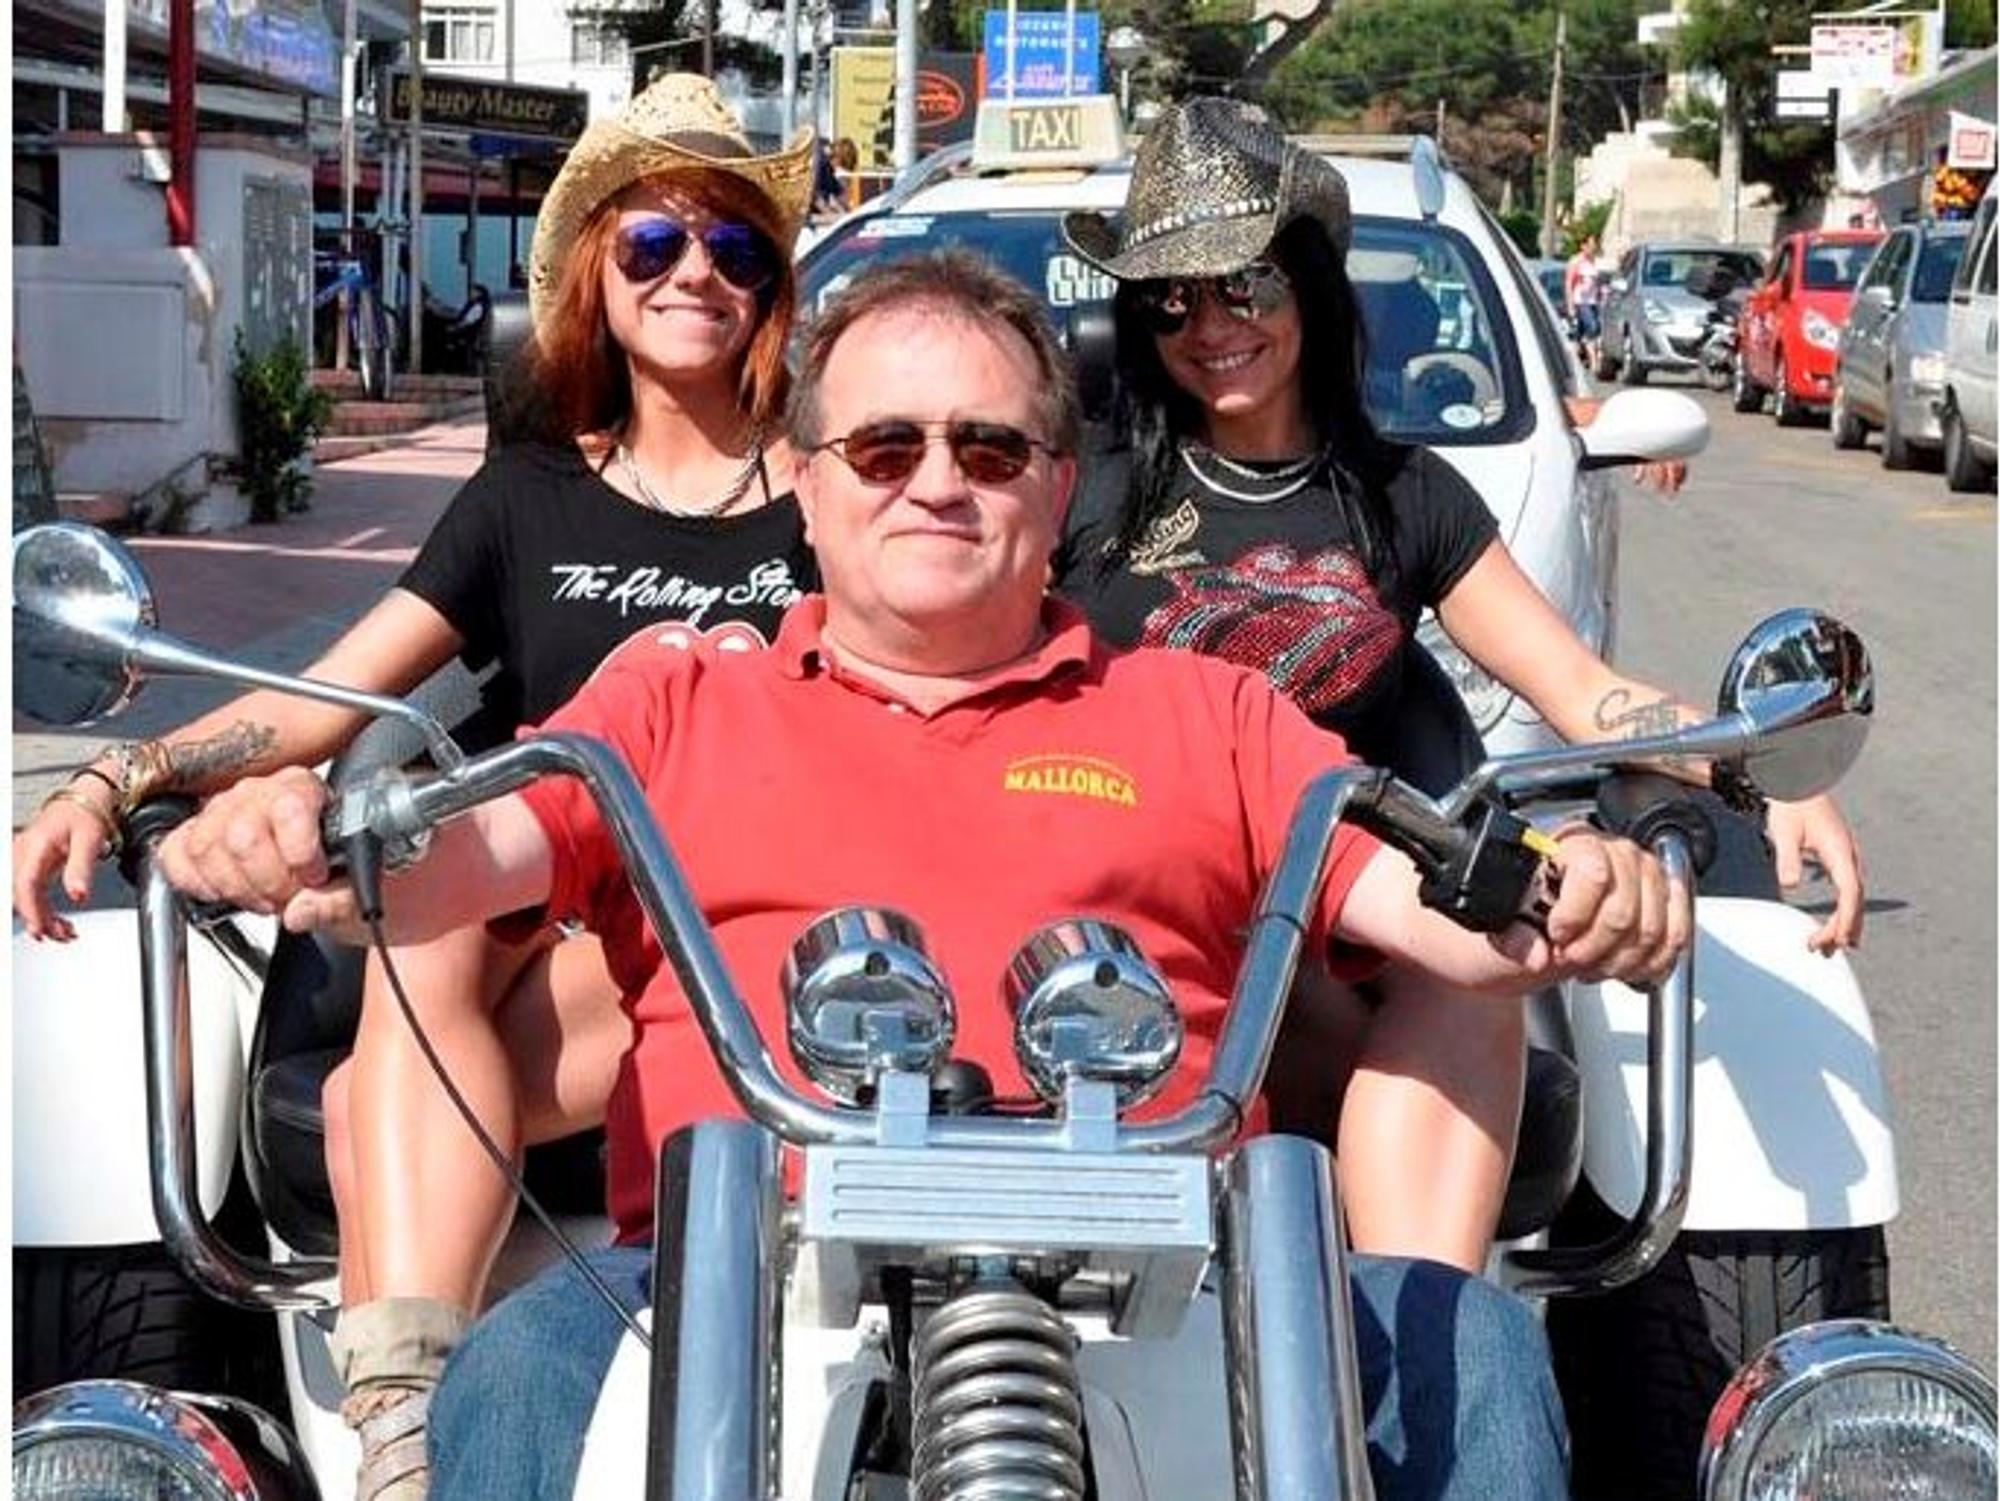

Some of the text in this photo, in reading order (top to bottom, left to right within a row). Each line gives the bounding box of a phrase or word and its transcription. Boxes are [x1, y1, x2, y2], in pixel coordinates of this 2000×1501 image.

[397, 79, 555, 119] Bauty Master
[1011, 108, 1080, 149] TAXI
[607, 566, 723, 628] Rolling
[1004, 767, 1136, 806] MALLORCA
